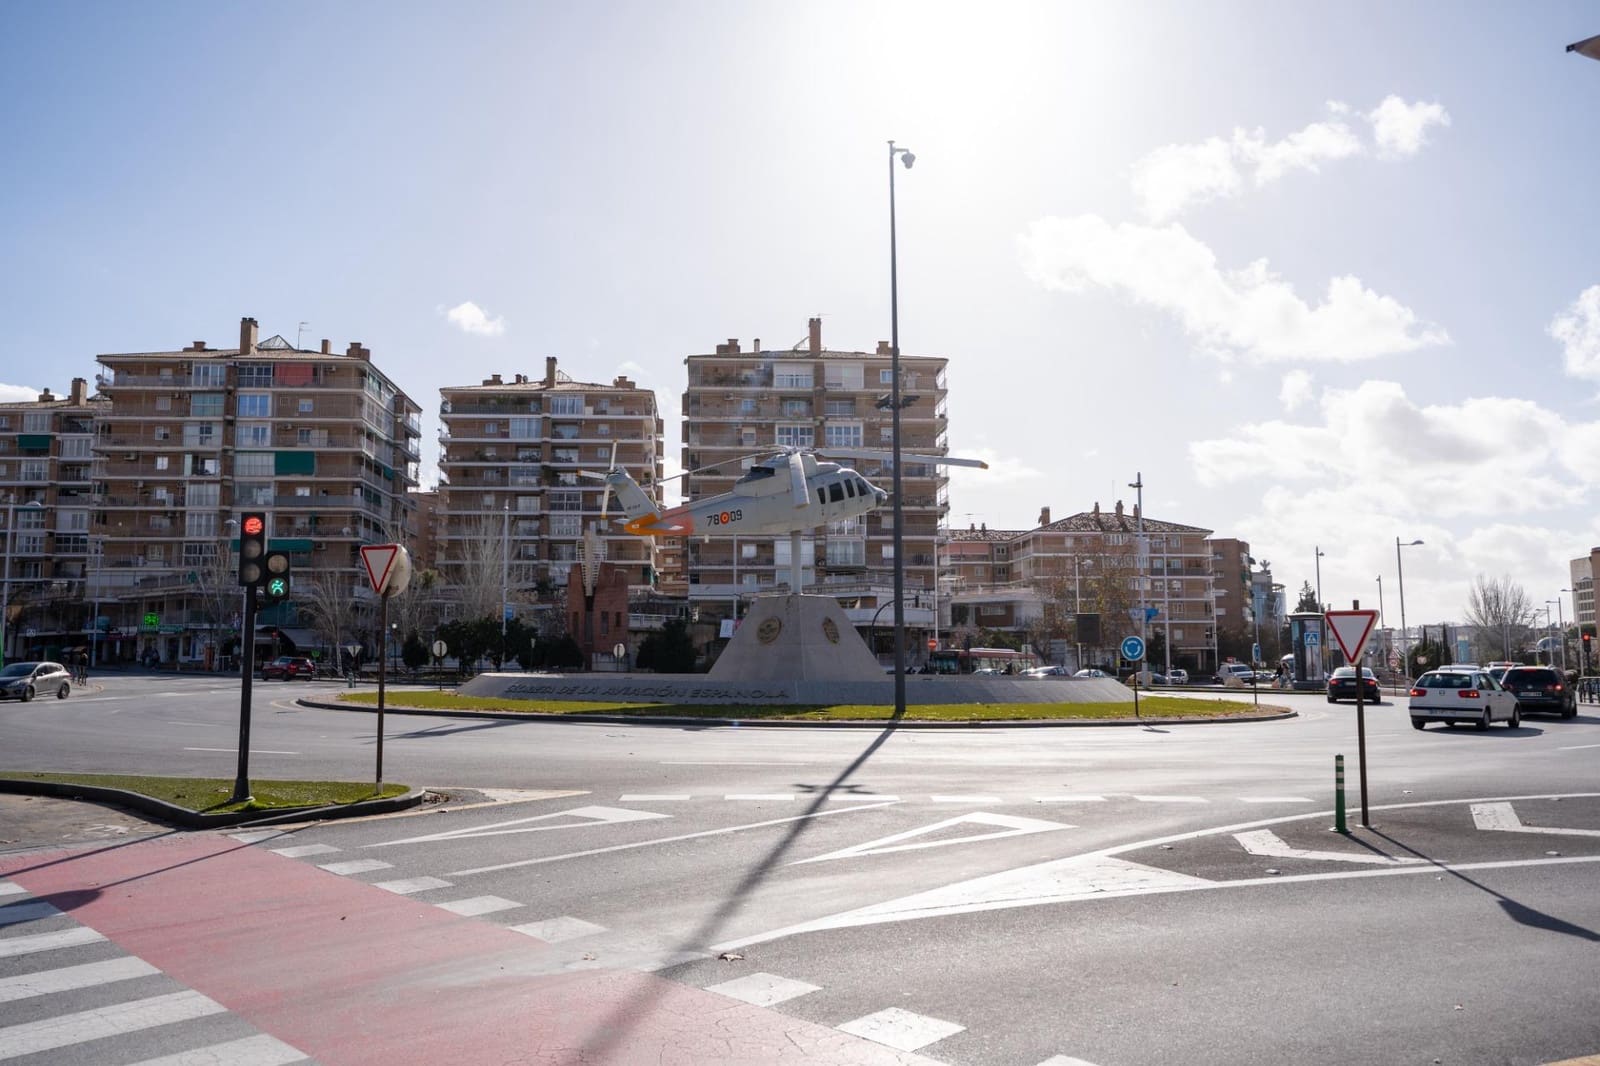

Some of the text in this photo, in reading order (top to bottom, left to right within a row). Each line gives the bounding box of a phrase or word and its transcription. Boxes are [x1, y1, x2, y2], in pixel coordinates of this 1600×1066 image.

[706, 509, 743, 527] 78 09
[557, 685, 579, 695] DE
[578, 685, 600, 696] LA
